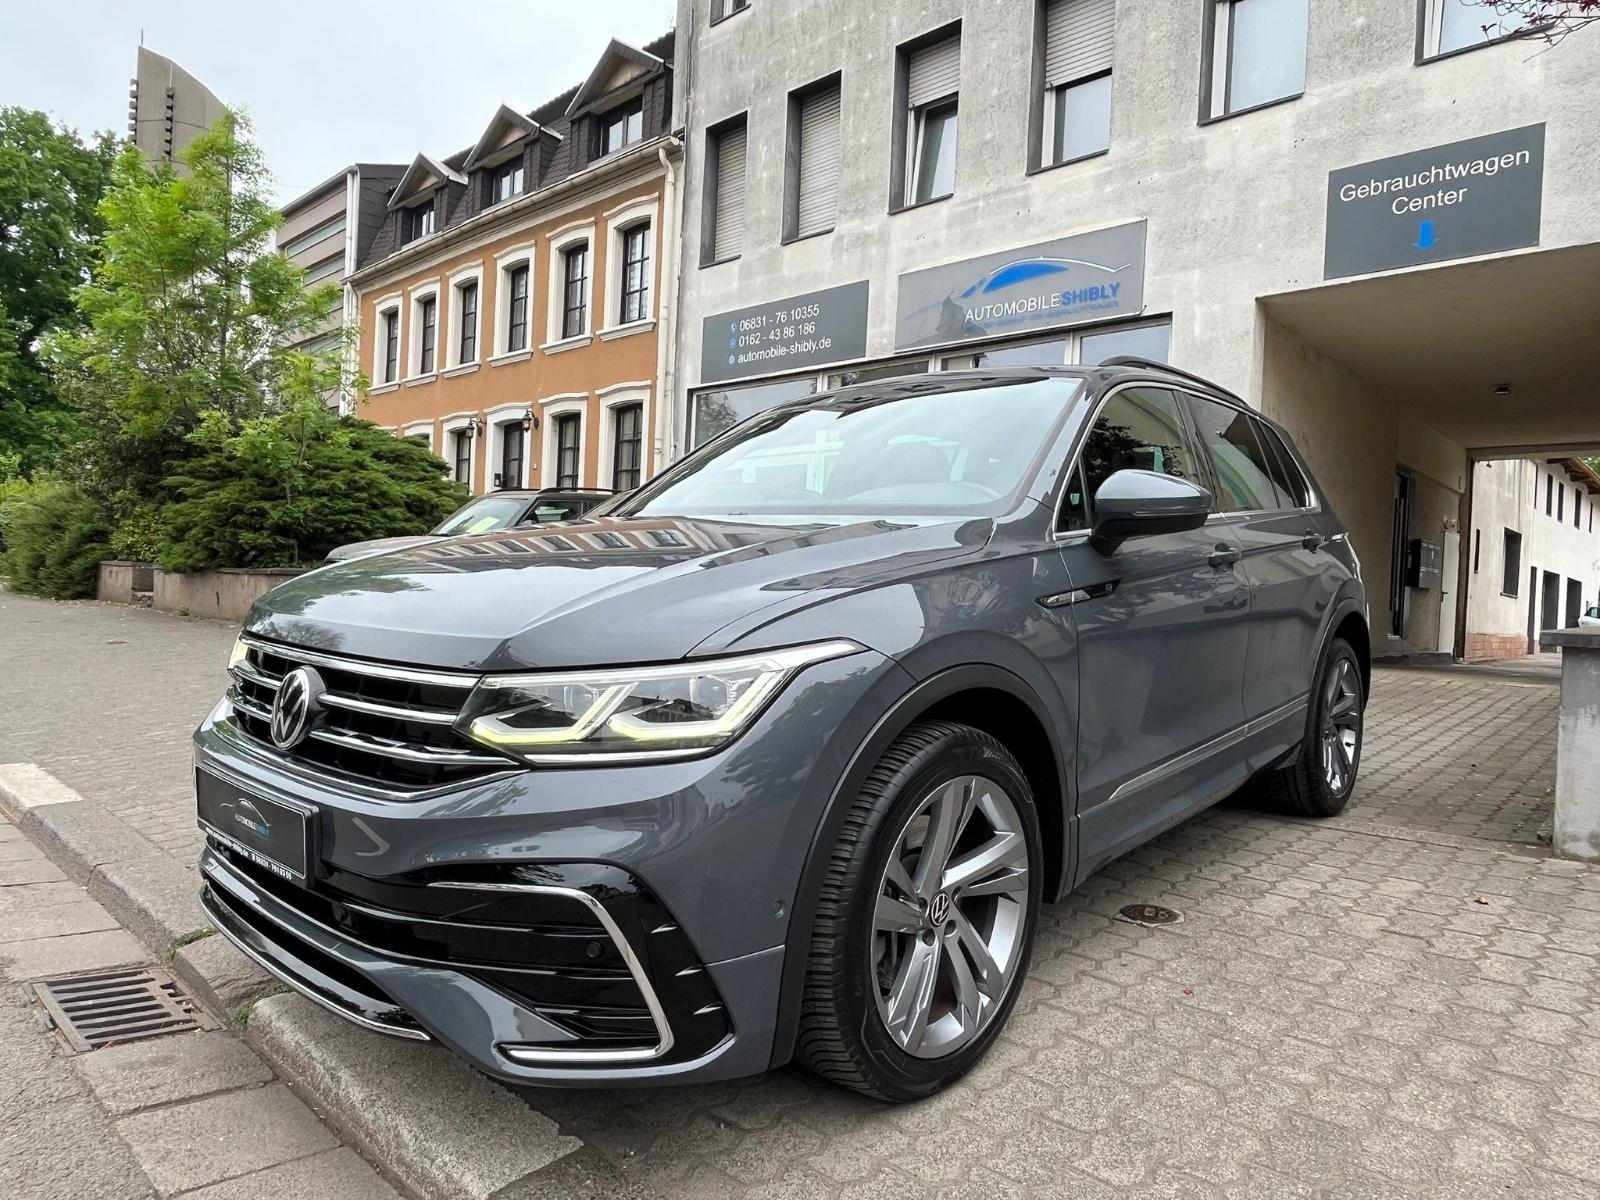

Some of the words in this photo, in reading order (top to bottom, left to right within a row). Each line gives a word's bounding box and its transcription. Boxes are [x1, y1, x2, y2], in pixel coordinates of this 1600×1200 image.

[1339, 149, 1530, 202] Gebrauchtwagen
[1391, 186, 1468, 215] Center
[739, 315, 766, 332] 06831
[775, 310, 788, 324] 76
[790, 303, 820, 321] 10355
[738, 332, 761, 348] 0162
[769, 327, 780, 341] 43
[782, 325, 795, 339] 86
[797, 321, 816, 336] 186
[737, 336, 832, 364] automobile-shibly.de
